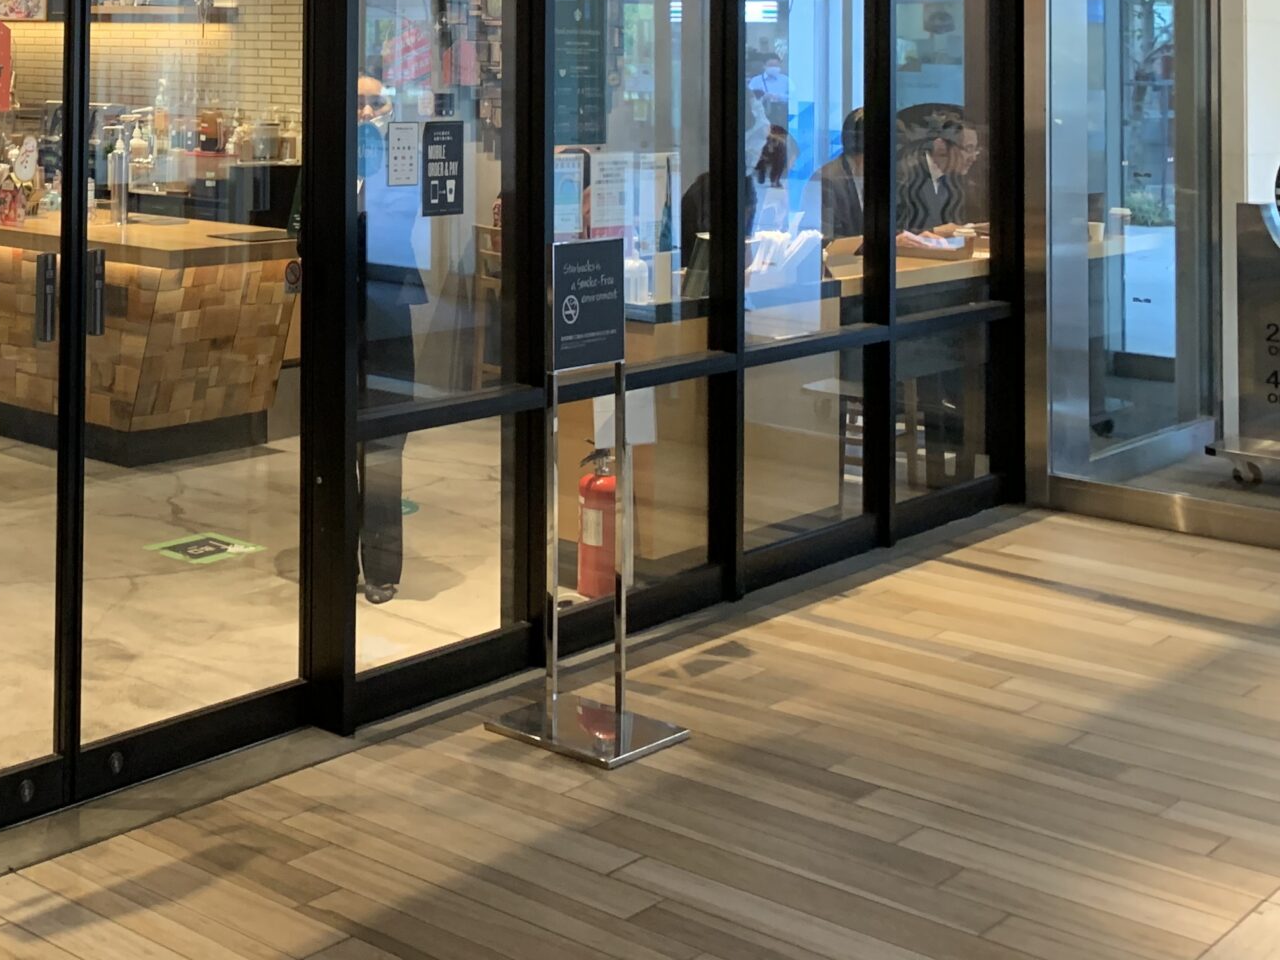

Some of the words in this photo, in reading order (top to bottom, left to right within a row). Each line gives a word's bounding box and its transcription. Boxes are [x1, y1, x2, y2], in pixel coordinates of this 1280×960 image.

[427, 144, 446, 160] MOBILE
[427, 161, 444, 177] ORDER
[449, 160, 459, 176] PAY
[563, 259, 595, 275] Starbucks
